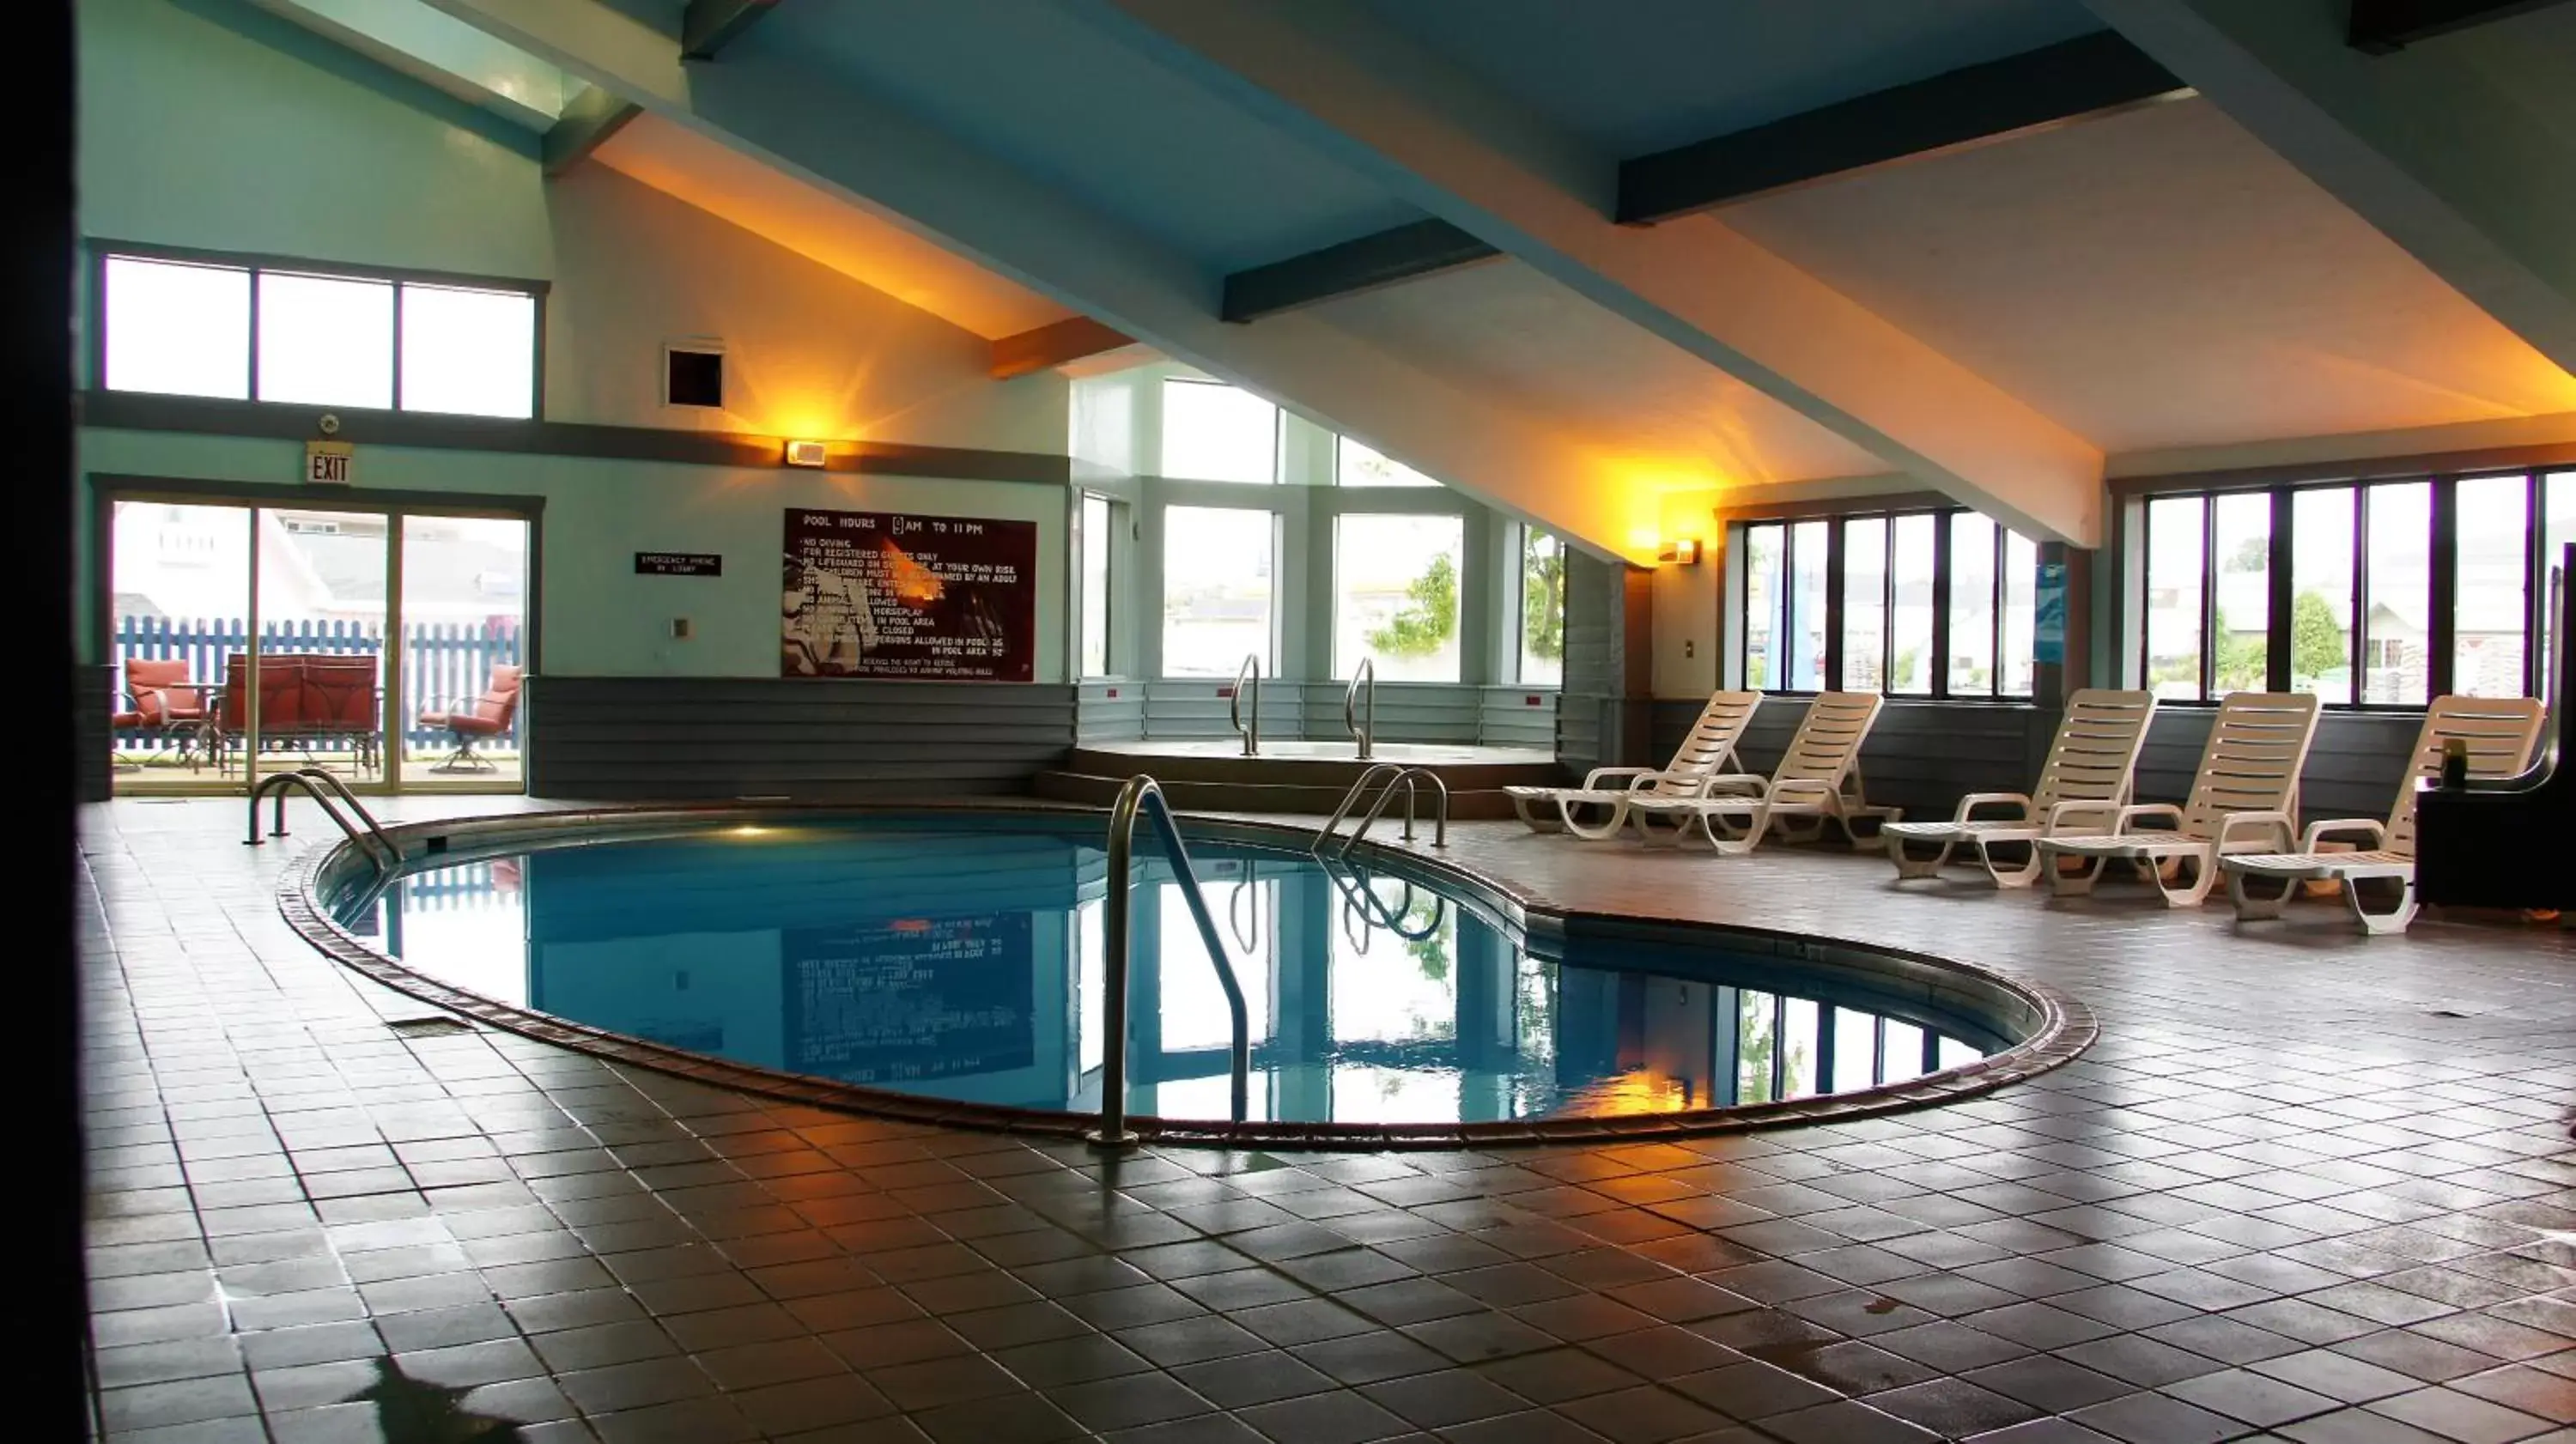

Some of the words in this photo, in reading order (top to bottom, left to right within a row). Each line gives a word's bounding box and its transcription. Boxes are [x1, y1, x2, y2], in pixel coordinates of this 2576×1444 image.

[313, 456, 349, 481] EXIT
[803, 514, 832, 527] POOL
[839, 517, 876, 529] HOURS
[905, 520, 922, 532] AM
[932, 521, 947, 533] TO
[953, 522, 963, 534] 11
[965, 523, 983, 536] PM
[804, 537, 817, 547] NO
[818, 538, 852, 549] DIVING
[803, 547, 821, 557] FOR
[823, 549, 878, 559] REGISTERED
[916, 552, 939, 561] ONLY
[818, 558, 865, 568] LIFEGUARD
[867, 560, 880, 568] ON
[933, 562, 942, 571] AT
[944, 562, 969, 573] YOUR
[971, 563, 993, 573] OWN
[866, 568, 890, 578] MUST
[992, 574, 1018, 584] ADULT
[873, 607, 924, 617] HORSEPLAY
[889, 617, 911, 626] POOL
[913, 617, 935, 627] AREA
[874, 635, 912, 645] PERSONS
[914, 636, 954, 646] ALLOWED
[942, 647, 963, 656] POOL
